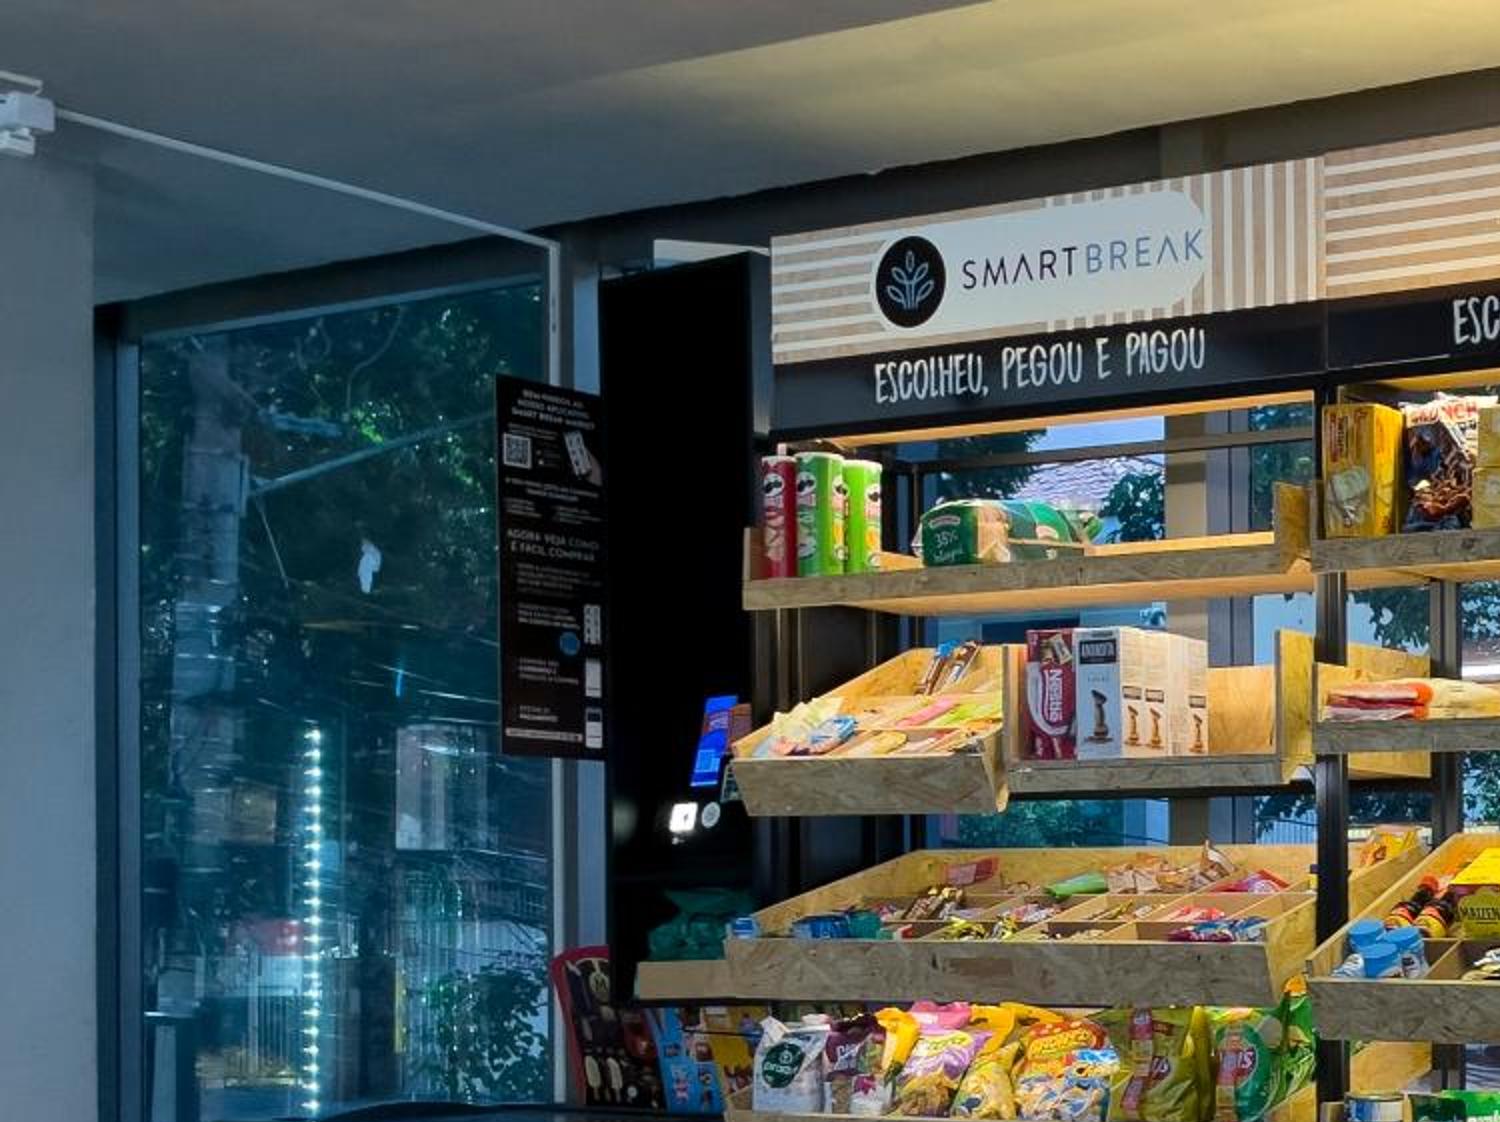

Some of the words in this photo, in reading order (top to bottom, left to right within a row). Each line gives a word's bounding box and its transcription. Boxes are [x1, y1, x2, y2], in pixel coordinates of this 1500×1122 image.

[962, 228, 1204, 290] SMARTBREAK
[875, 356, 989, 403] ESCOLHEU,
[1001, 343, 1085, 391] PEGOU
[1097, 338, 1112, 380] E
[1125, 328, 1206, 376] PAGOU
